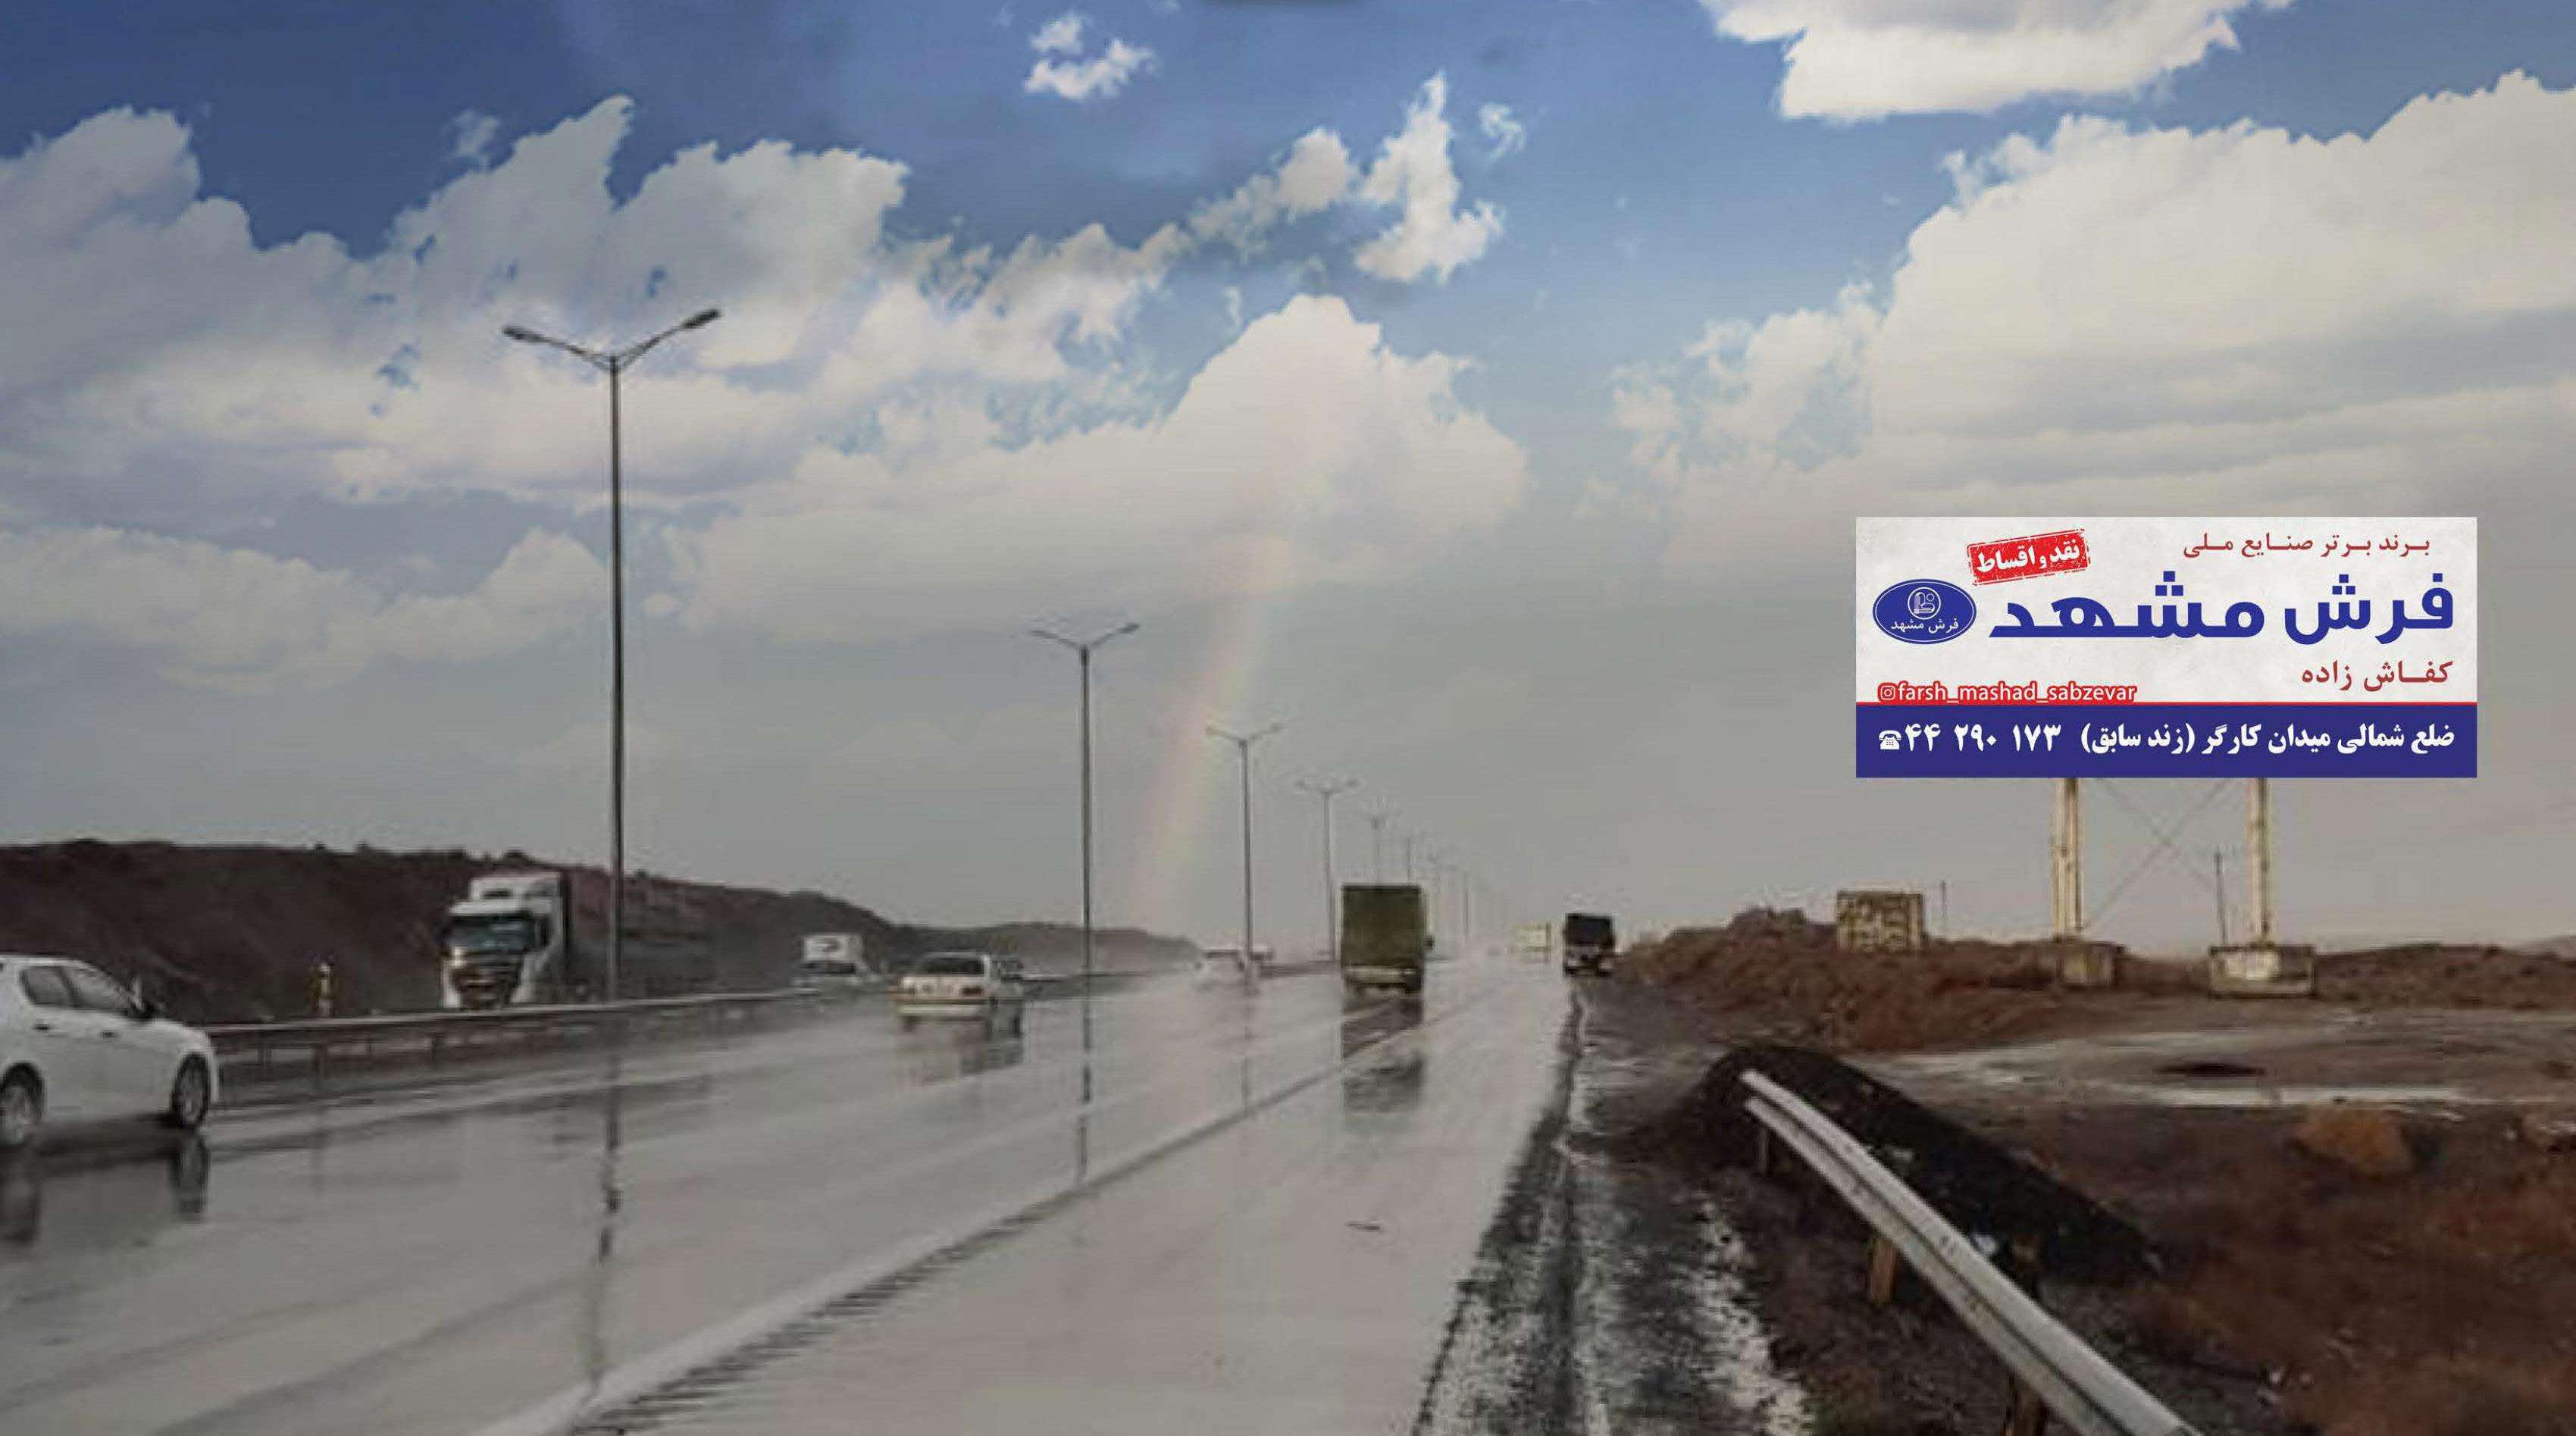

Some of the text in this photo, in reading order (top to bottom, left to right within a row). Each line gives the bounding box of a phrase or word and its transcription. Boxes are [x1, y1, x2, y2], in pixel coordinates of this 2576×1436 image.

[1976, 539, 2080, 573] نقد و اقساط
[2183, 532, 2430, 558] برند برتر صنایع ملی
[1989, 570, 2454, 646] فرش مشهد
[1890, 618, 1960, 634] فرش مشهد
[2301, 660, 2454, 692] کفاش زاده
[1905, 723, 2061, 752] ۴۴ ۲۹۰ ۱۷۳
[2080, 722, 2455, 755] ضلع شمالی میدان کارگر (زند سابق)
